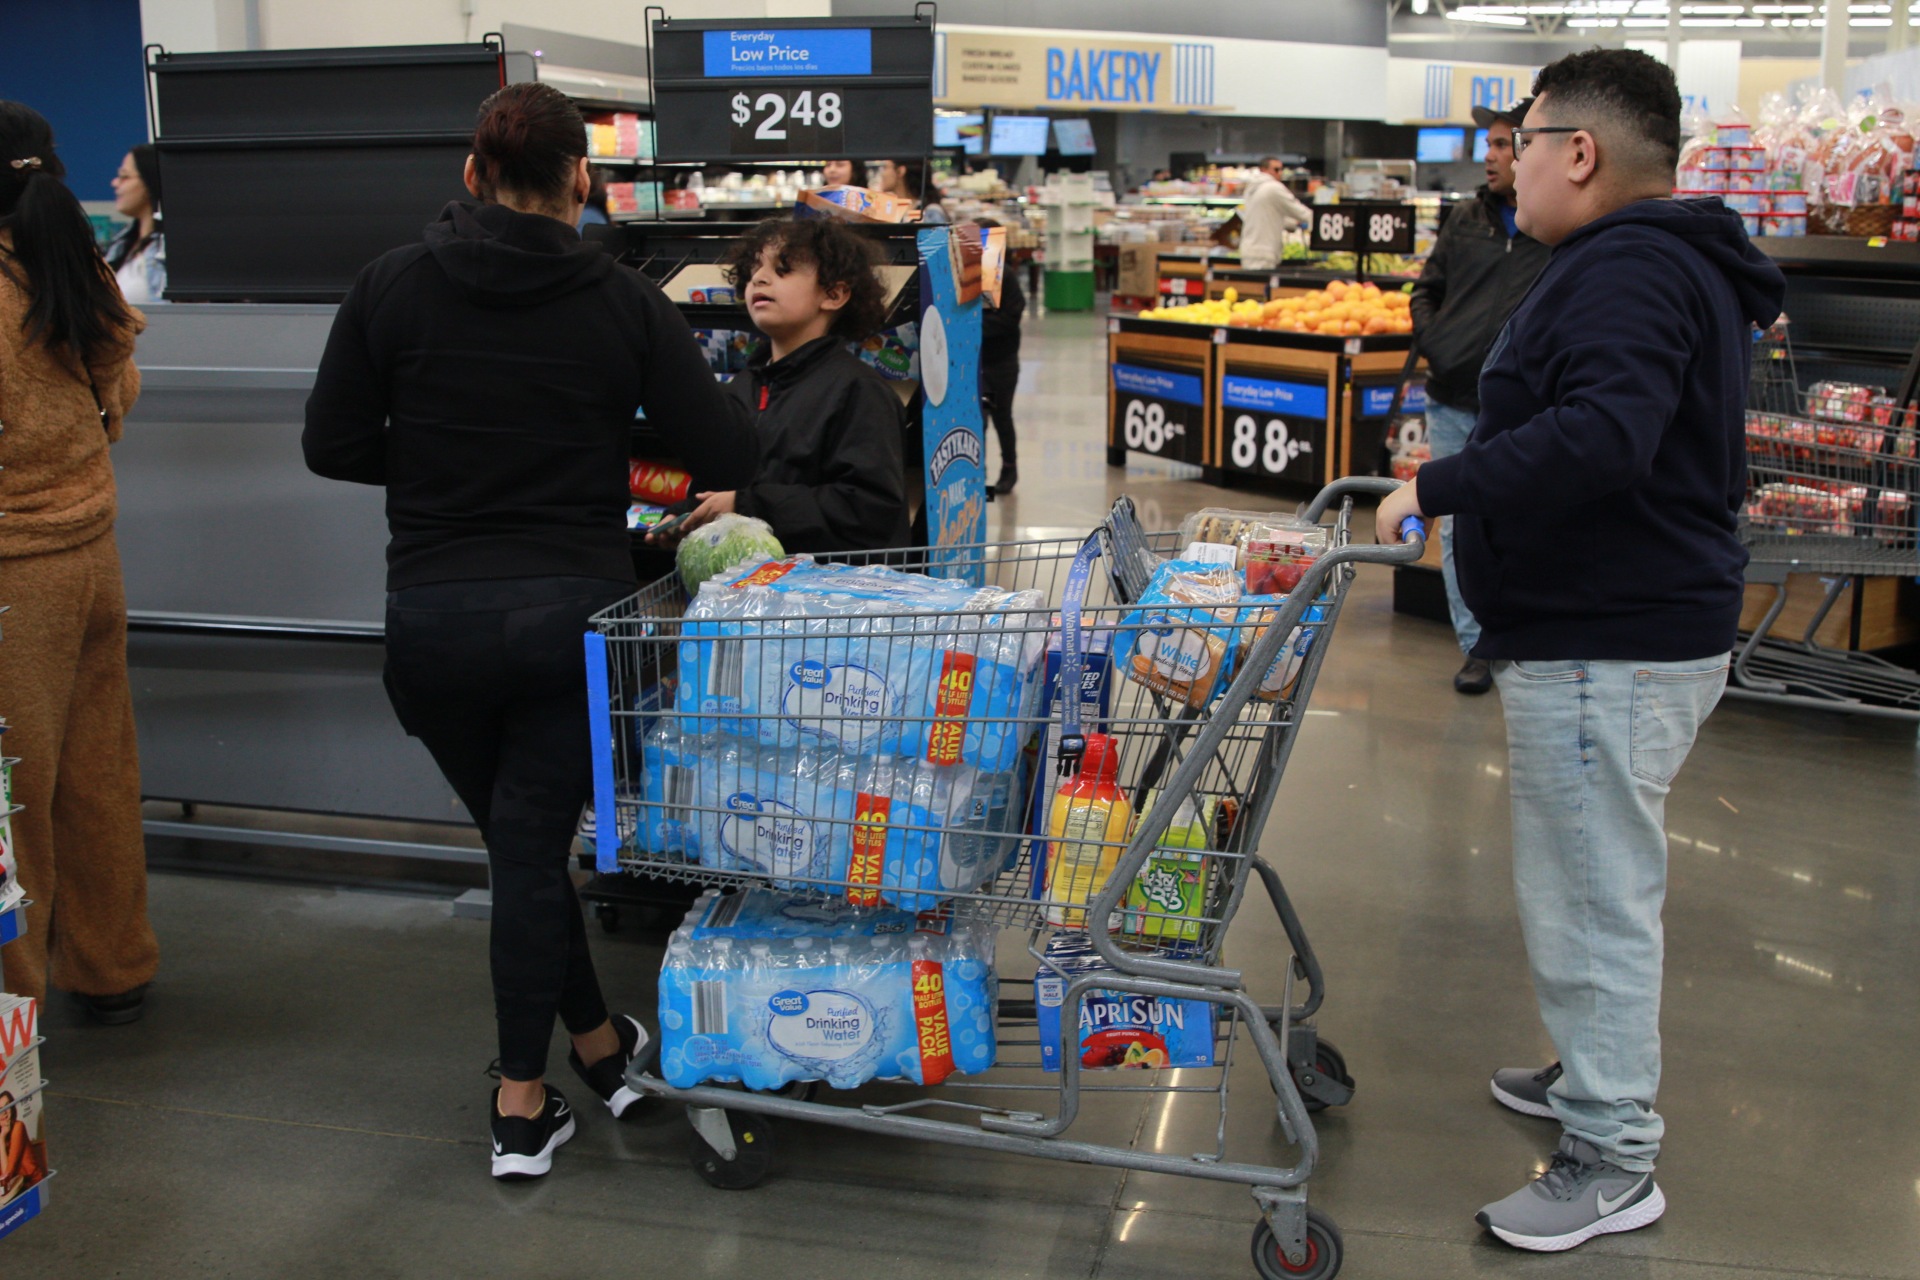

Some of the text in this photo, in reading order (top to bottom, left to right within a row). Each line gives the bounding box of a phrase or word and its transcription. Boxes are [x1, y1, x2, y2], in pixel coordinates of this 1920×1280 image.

[730, 31, 775, 43] Everyday
[731, 45, 810, 62] Low Price
[1046, 47, 1162, 103] BAKERY
[930, 431, 981, 486] TASTYKAKE
[1065, 611, 1076, 657] Walmart
[1160, 642, 1198, 671] White
[794, 664, 824, 678] Great
[942, 670, 972, 692] 40
[825, 692, 880, 714] Drinking
[857, 811, 887, 832] 40
[758, 826, 804, 851] Drinking
[914, 973, 942, 993] 40
[772, 996, 803, 1007] Great
[827, 1006, 859, 1018] Purified
[806, 1017, 860, 1031] Drinking
[919, 1009, 949, 1060] VALUE PACK
[823, 1029, 861, 1041] Water
